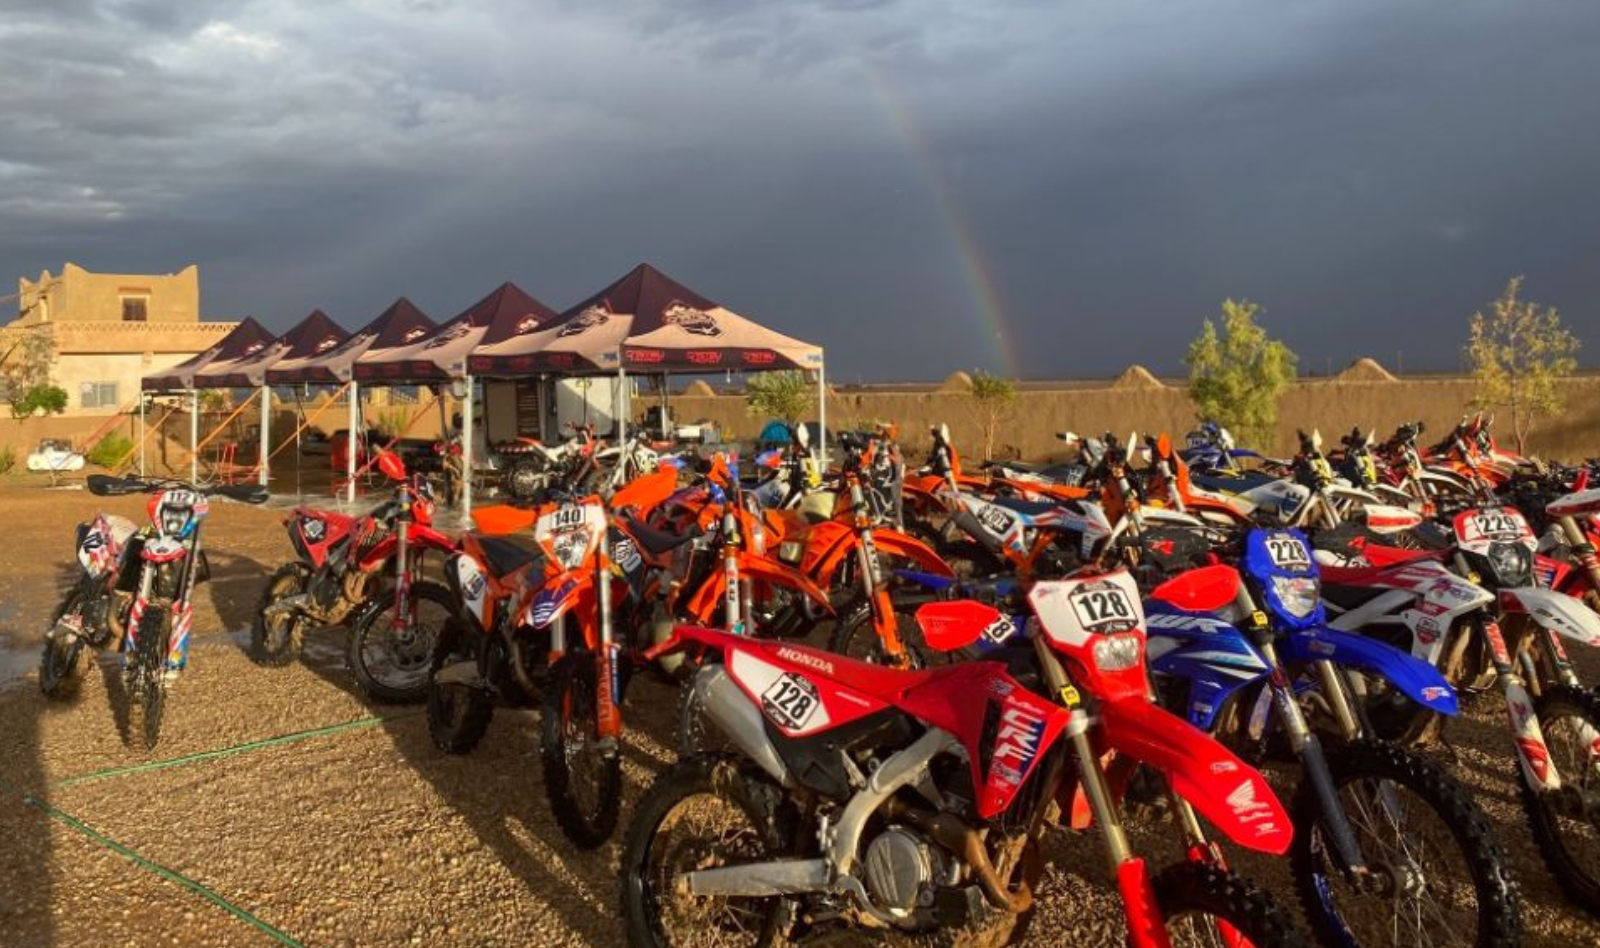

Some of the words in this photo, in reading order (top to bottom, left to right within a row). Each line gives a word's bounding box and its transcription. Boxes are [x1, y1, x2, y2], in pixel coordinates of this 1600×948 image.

[554, 508, 582, 525] 140
[1478, 514, 1519, 533] 229
[1270, 540, 1307, 562] 228
[1078, 591, 1129, 621] 128
[776, 646, 835, 675] HONDA
[772, 681, 813, 720] 128
